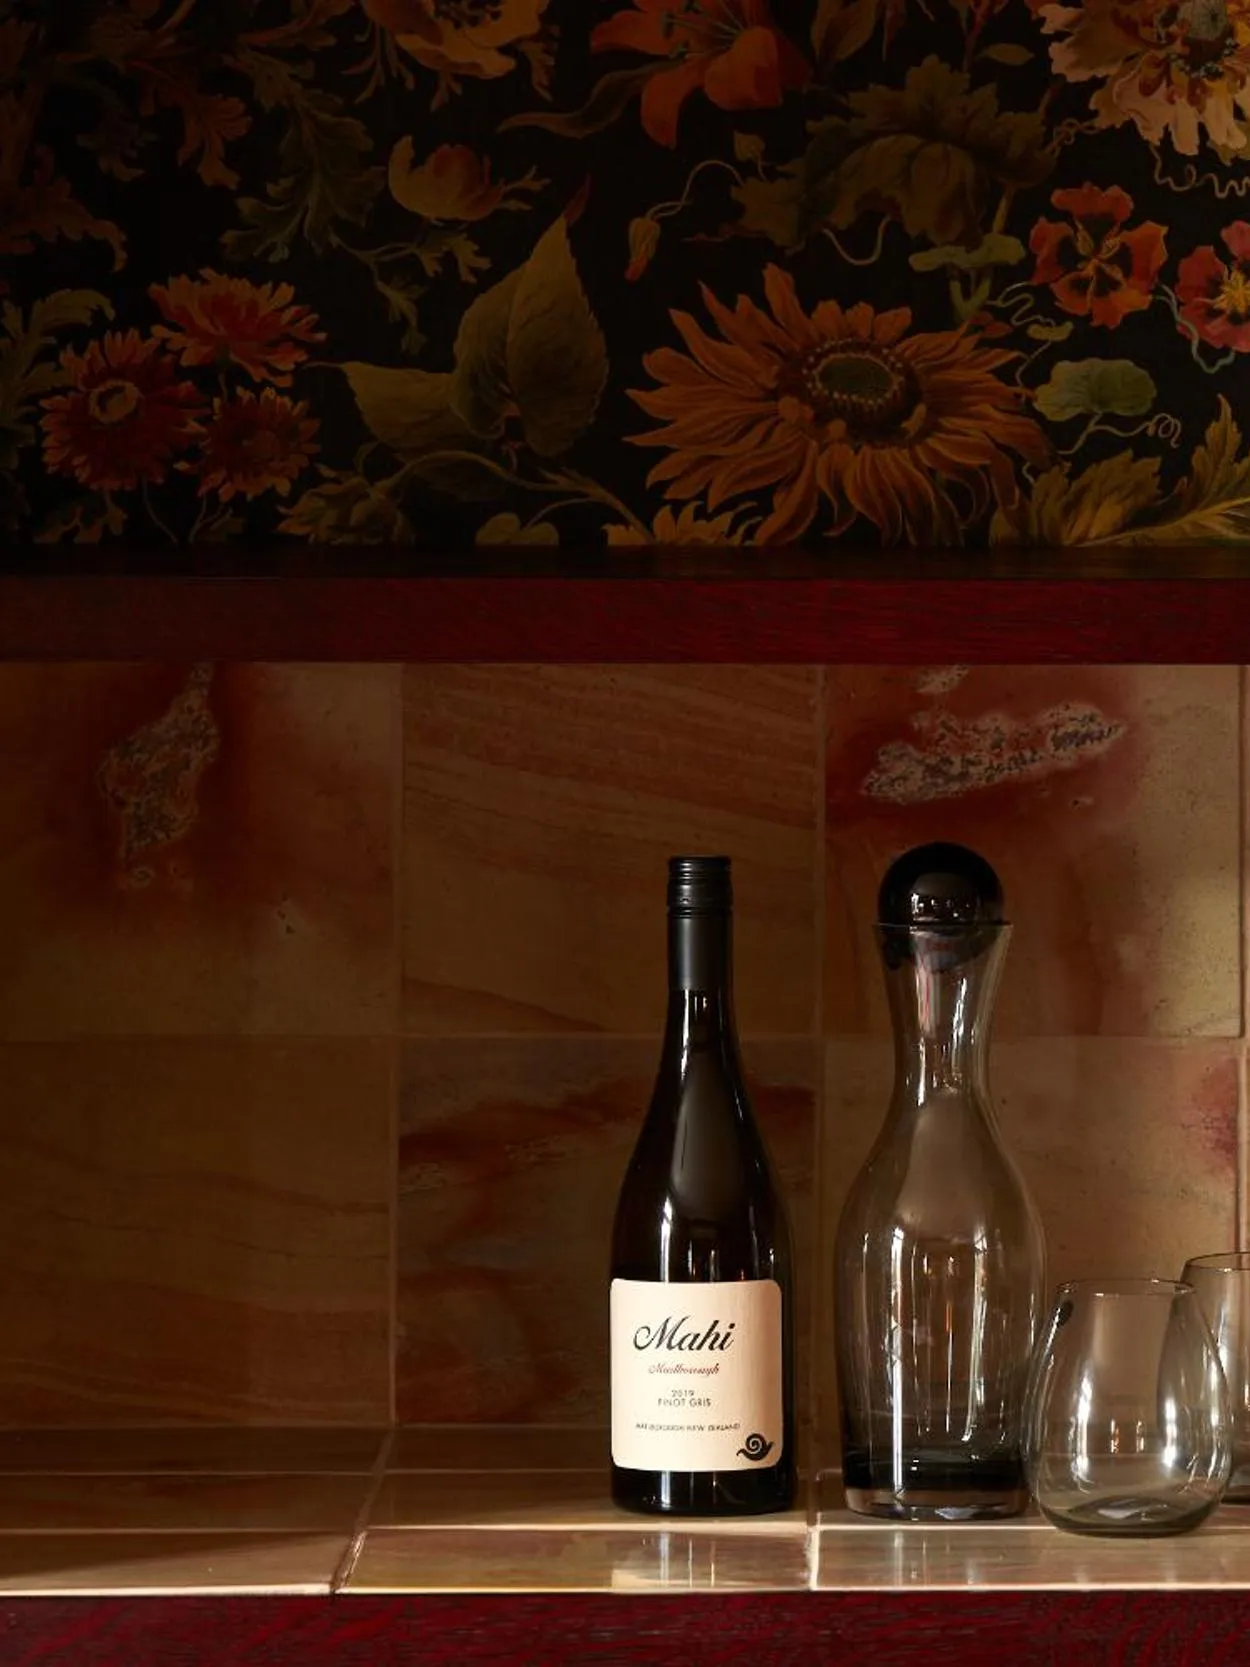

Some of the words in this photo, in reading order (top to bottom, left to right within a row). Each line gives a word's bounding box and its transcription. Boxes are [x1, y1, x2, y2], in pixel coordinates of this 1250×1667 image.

[633, 1315, 736, 1351] Mahi
[671, 1389, 695, 1397] 2019
[657, 1398, 686, 1407] PINOT
[689, 1398, 711, 1407] GRIS
